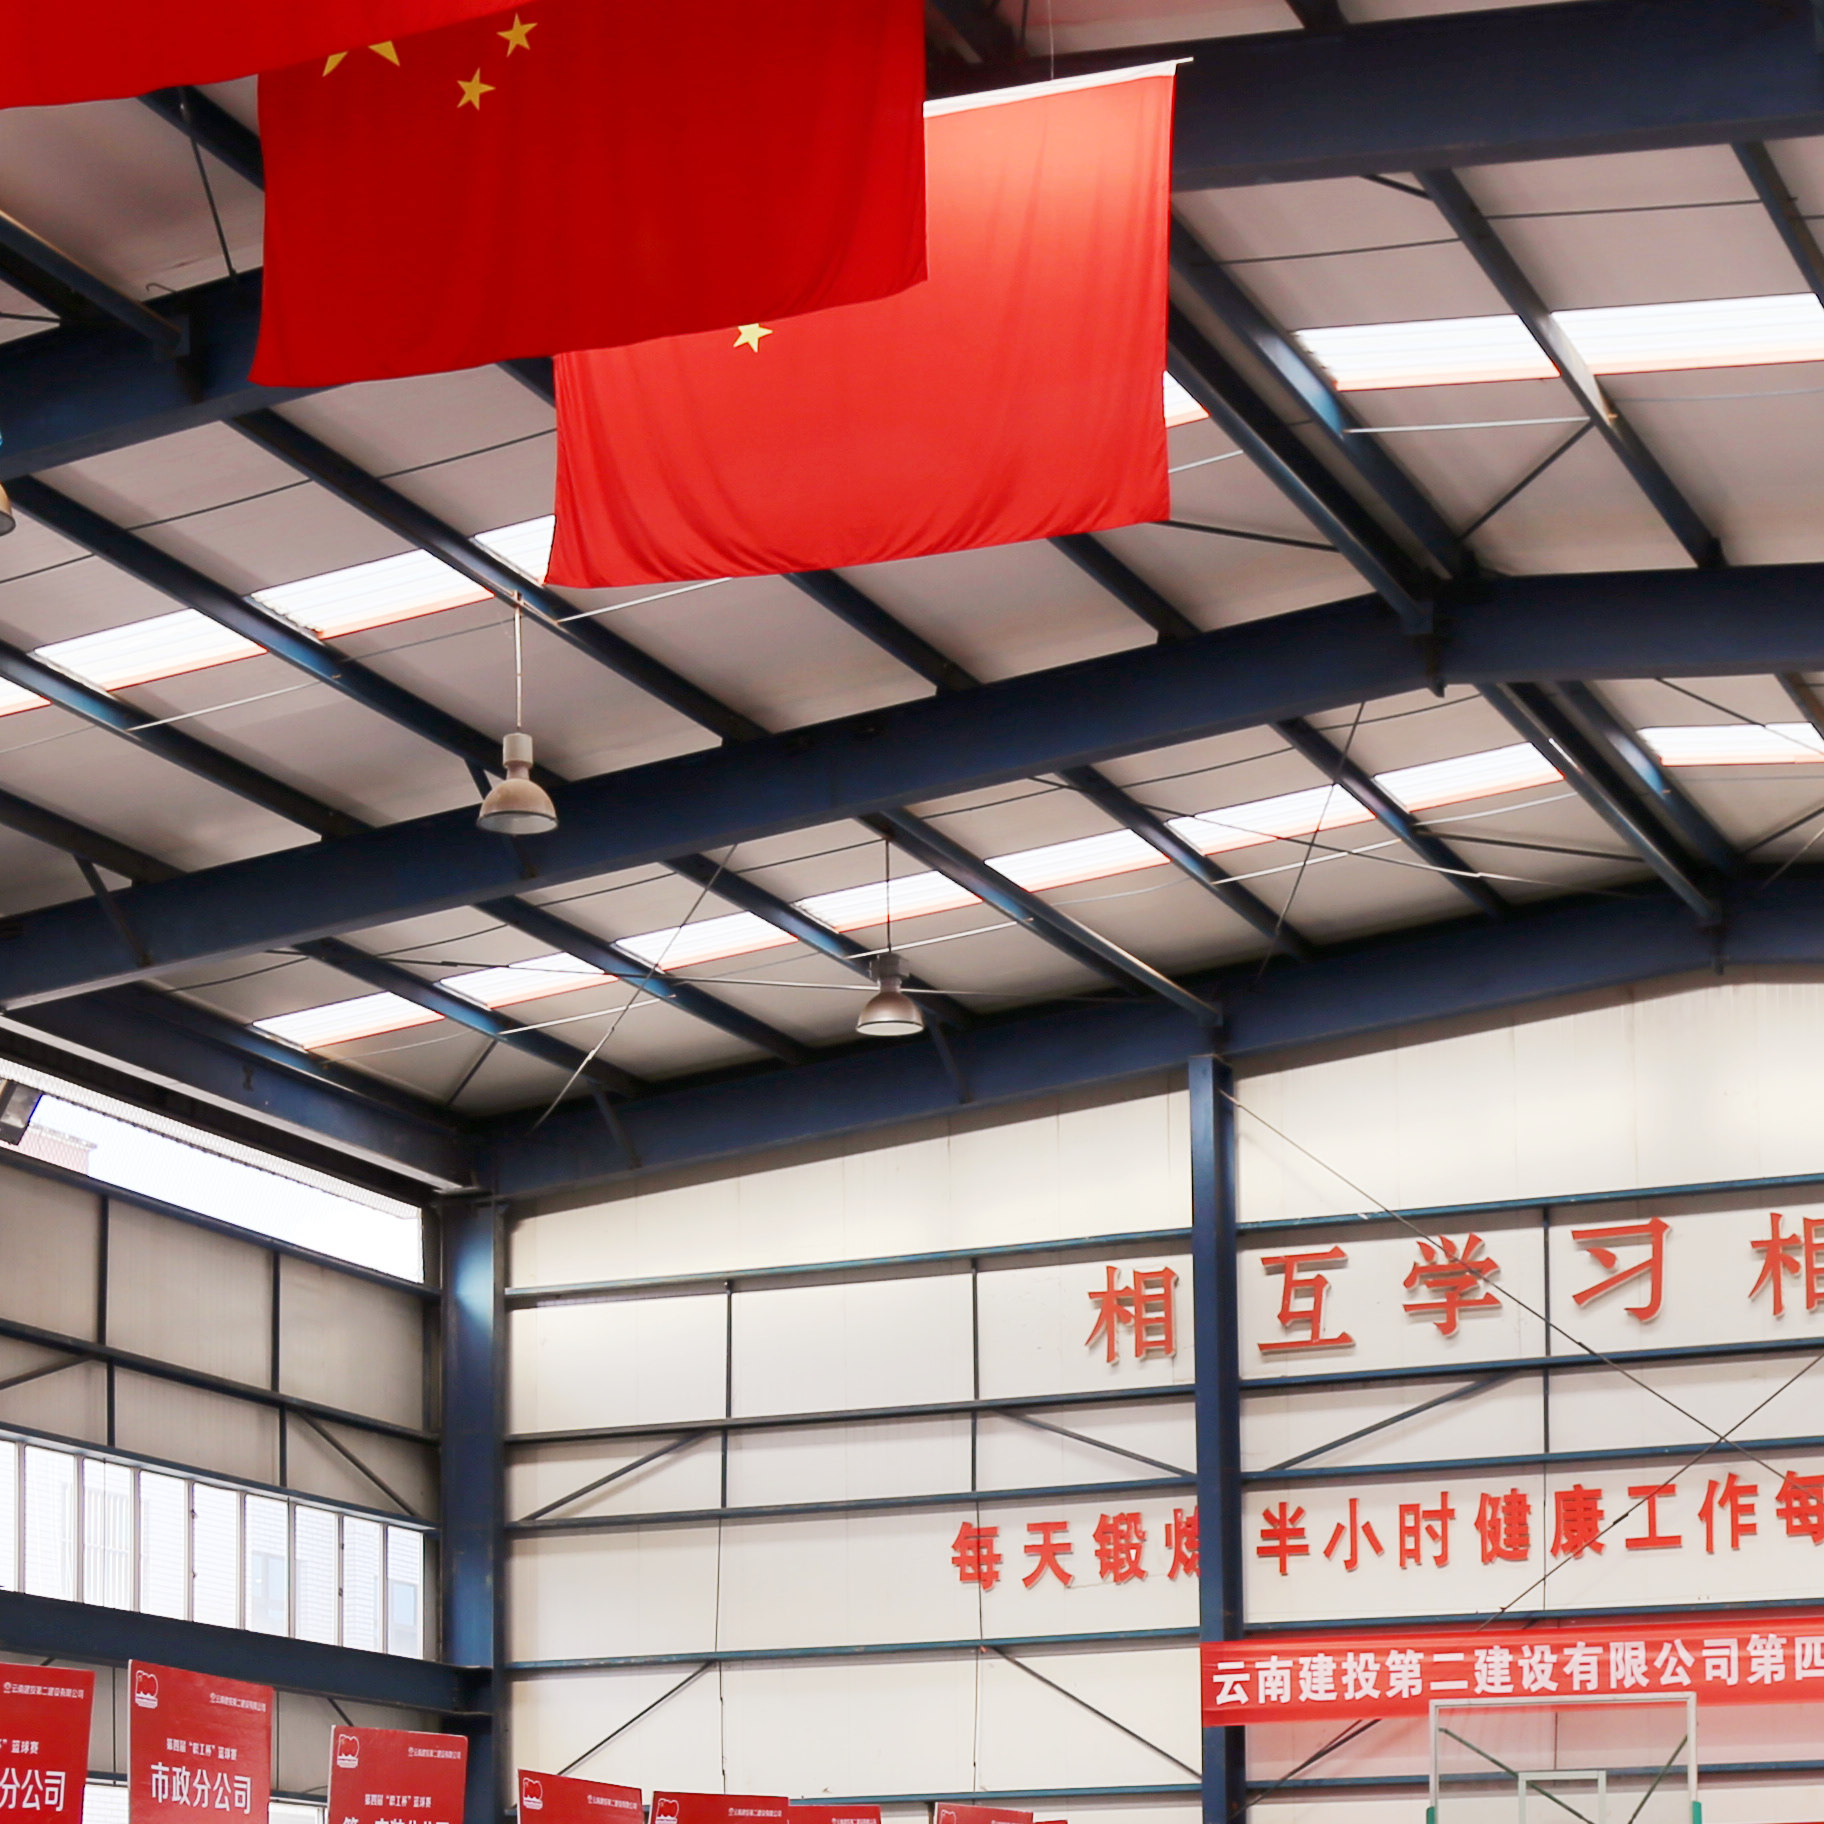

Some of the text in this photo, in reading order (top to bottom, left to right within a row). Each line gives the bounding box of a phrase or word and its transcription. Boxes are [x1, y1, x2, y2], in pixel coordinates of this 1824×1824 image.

[150, 1761, 252, 1815] 市政分公司
